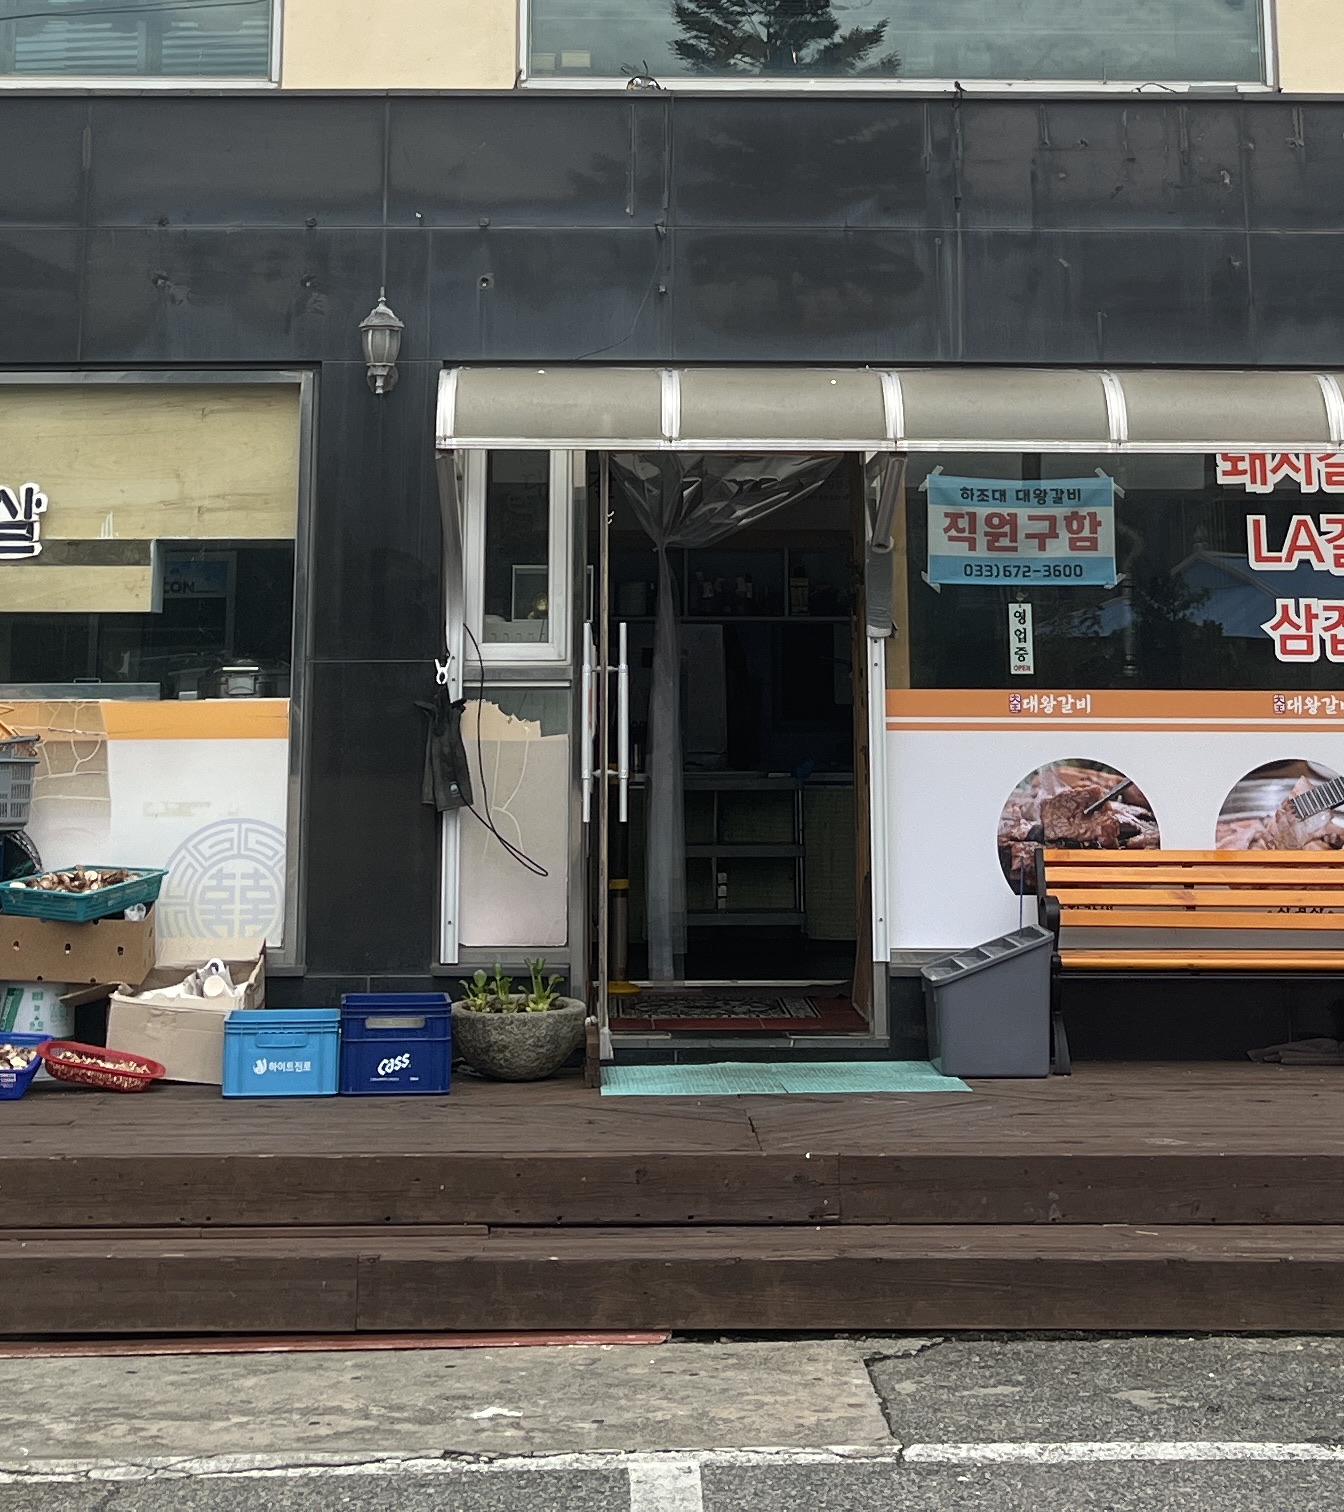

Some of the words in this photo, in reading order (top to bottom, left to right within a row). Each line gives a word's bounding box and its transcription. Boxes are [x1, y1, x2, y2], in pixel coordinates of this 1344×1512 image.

[959, 487, 1007, 503] 하조대
[1015, 488, 1082, 505] 대왕갈비
[943, 511, 1103, 553] 직원구함
[963, 563, 1084, 578] 033)672-3600
[1022, 693, 1092, 714] 대왕갈비
[268, 1060, 312, 1073] 하이트진로
